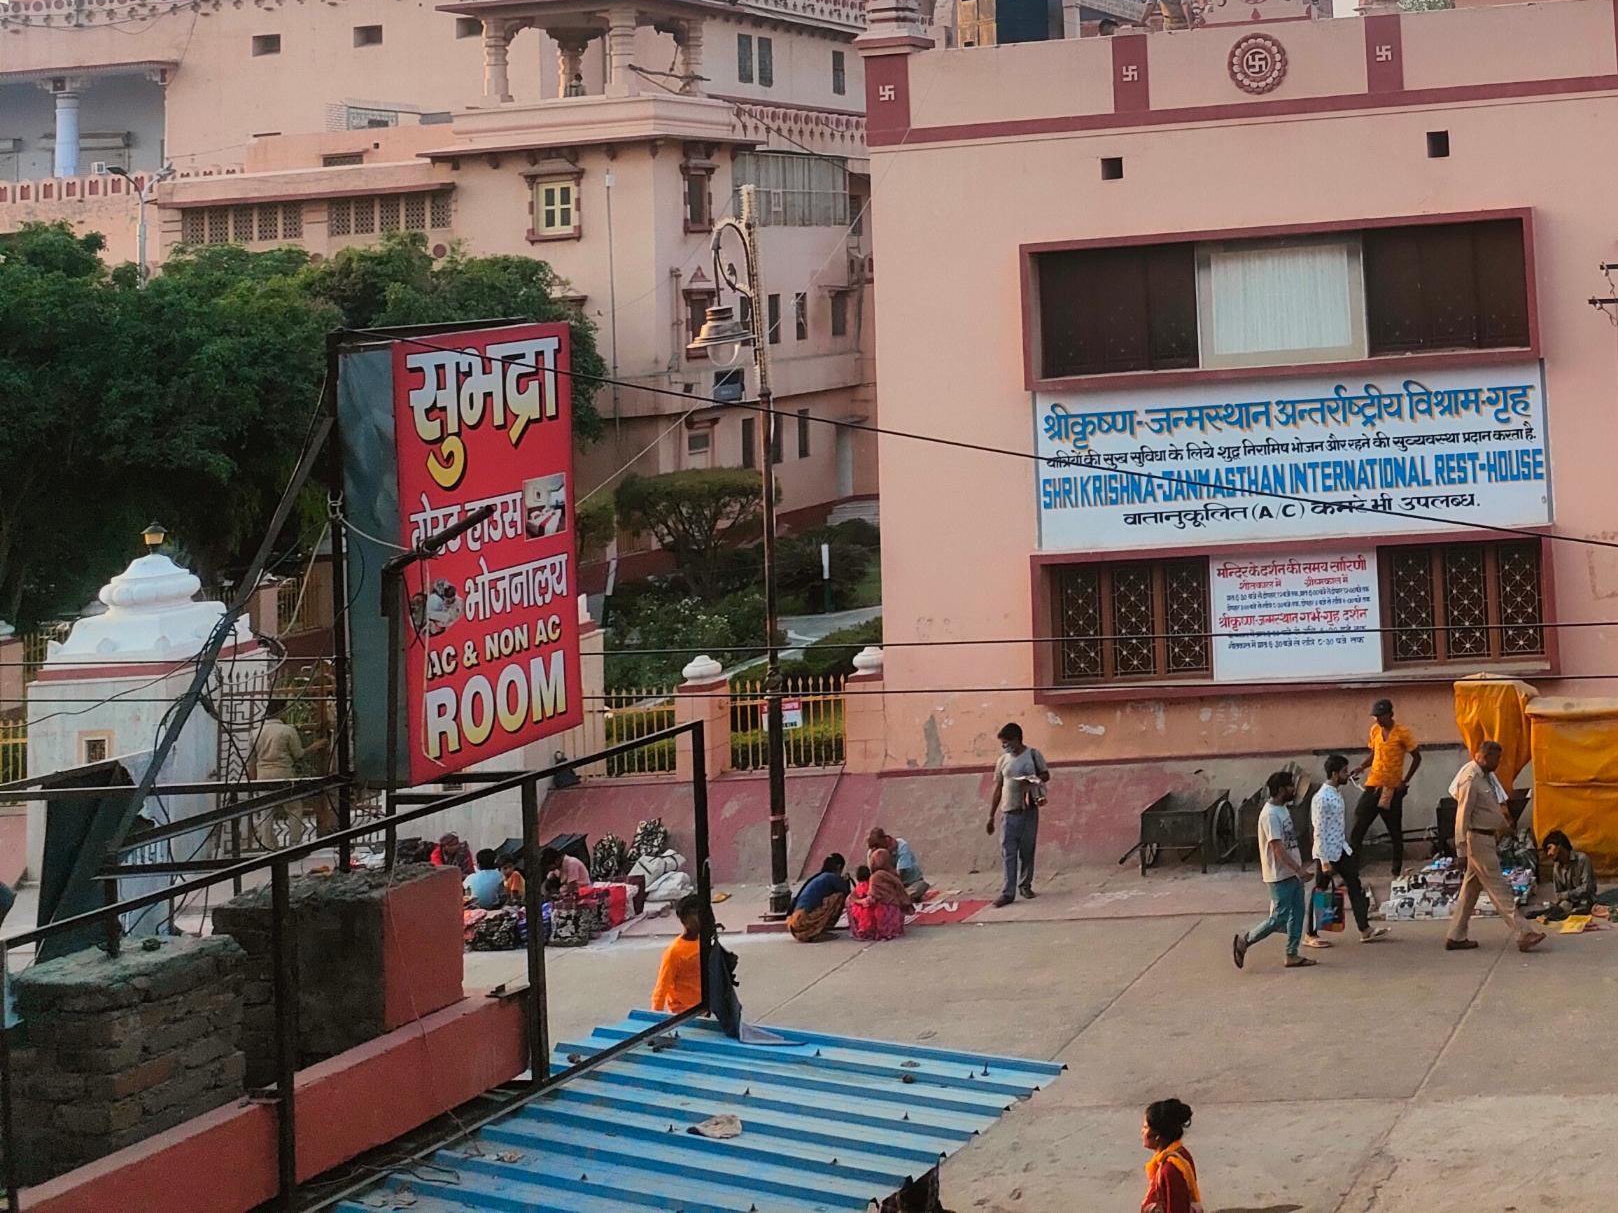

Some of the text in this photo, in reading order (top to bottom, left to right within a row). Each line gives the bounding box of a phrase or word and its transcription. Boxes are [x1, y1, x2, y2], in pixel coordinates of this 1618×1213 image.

[406, 336, 560, 488] सुभद्रा
[1402, 380, 1535, 423] विश्राम-गृह
[1103, 453, 1128, 472] सुख
[1130, 445, 1167, 468] सुविधा
[1168, 443, 1184, 461] के
[1186, 441, 1215, 459] लिये
[1291, 435, 1324, 454] भोजन
[1326, 432, 1347, 452] और
[1348, 434, 1371, 453] रहने
[1373, 431, 1390, 449] की
[1462, 429, 1491, 444] प्रदान
[1493, 427, 1524, 442] करता
[1290, 454, 1431, 493] INTERNATIONAL
[1434, 449, 1544, 485] REST-HOUSE
[464, 490, 523, 552] हाउस
[1122, 502, 1248, 530] वातानुकूलित
[1370, 493, 1394, 512] भी
[463, 553, 568, 622] भोजनालय
[425, 614, 562, 680] AC & NON AC
[425, 648, 568, 760] ROOM
